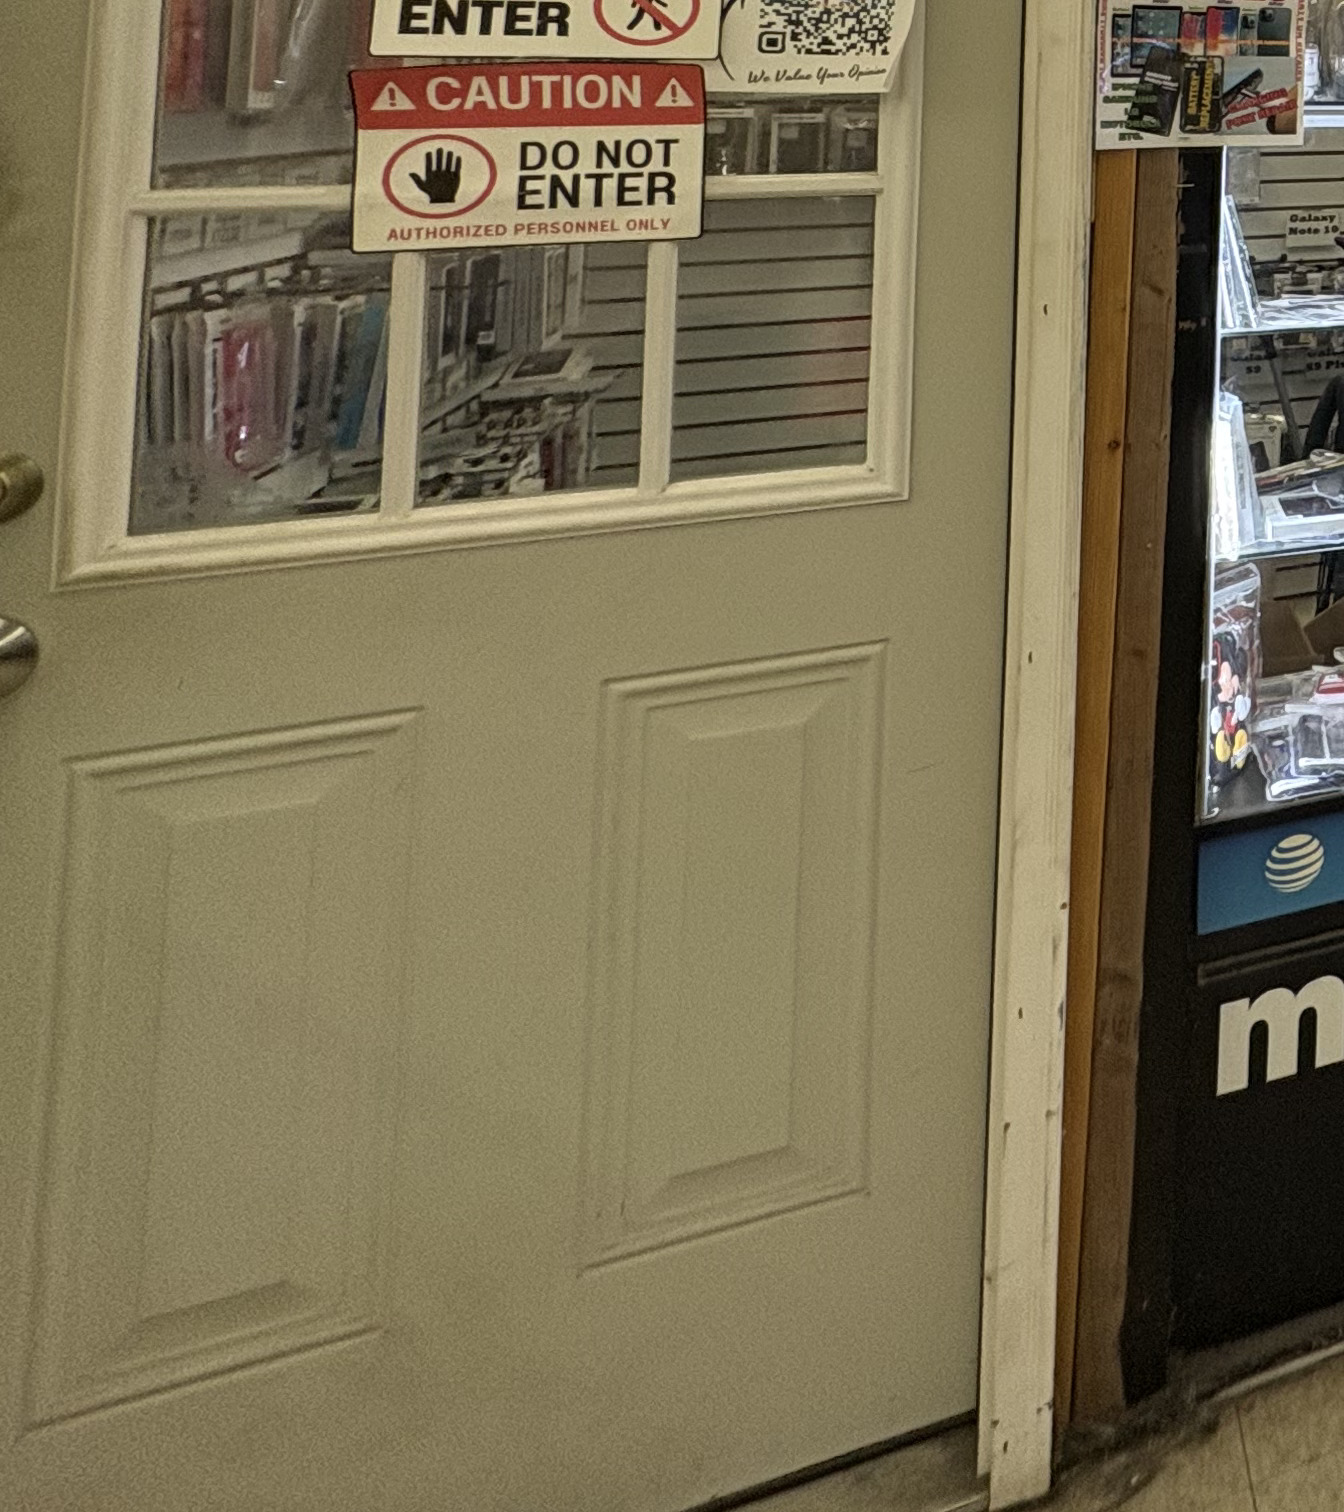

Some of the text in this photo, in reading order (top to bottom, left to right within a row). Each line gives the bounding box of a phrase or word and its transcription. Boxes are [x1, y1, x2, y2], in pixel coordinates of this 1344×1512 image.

[425, 73, 644, 113] CAUTION
[519, 138, 681, 172] DO NOT
[516, 171, 678, 211] ENTER
[386, 217, 672, 243] AUTHORIZED PERSONNEL ONLY
[1289, 212, 1337, 224] Galaxy
